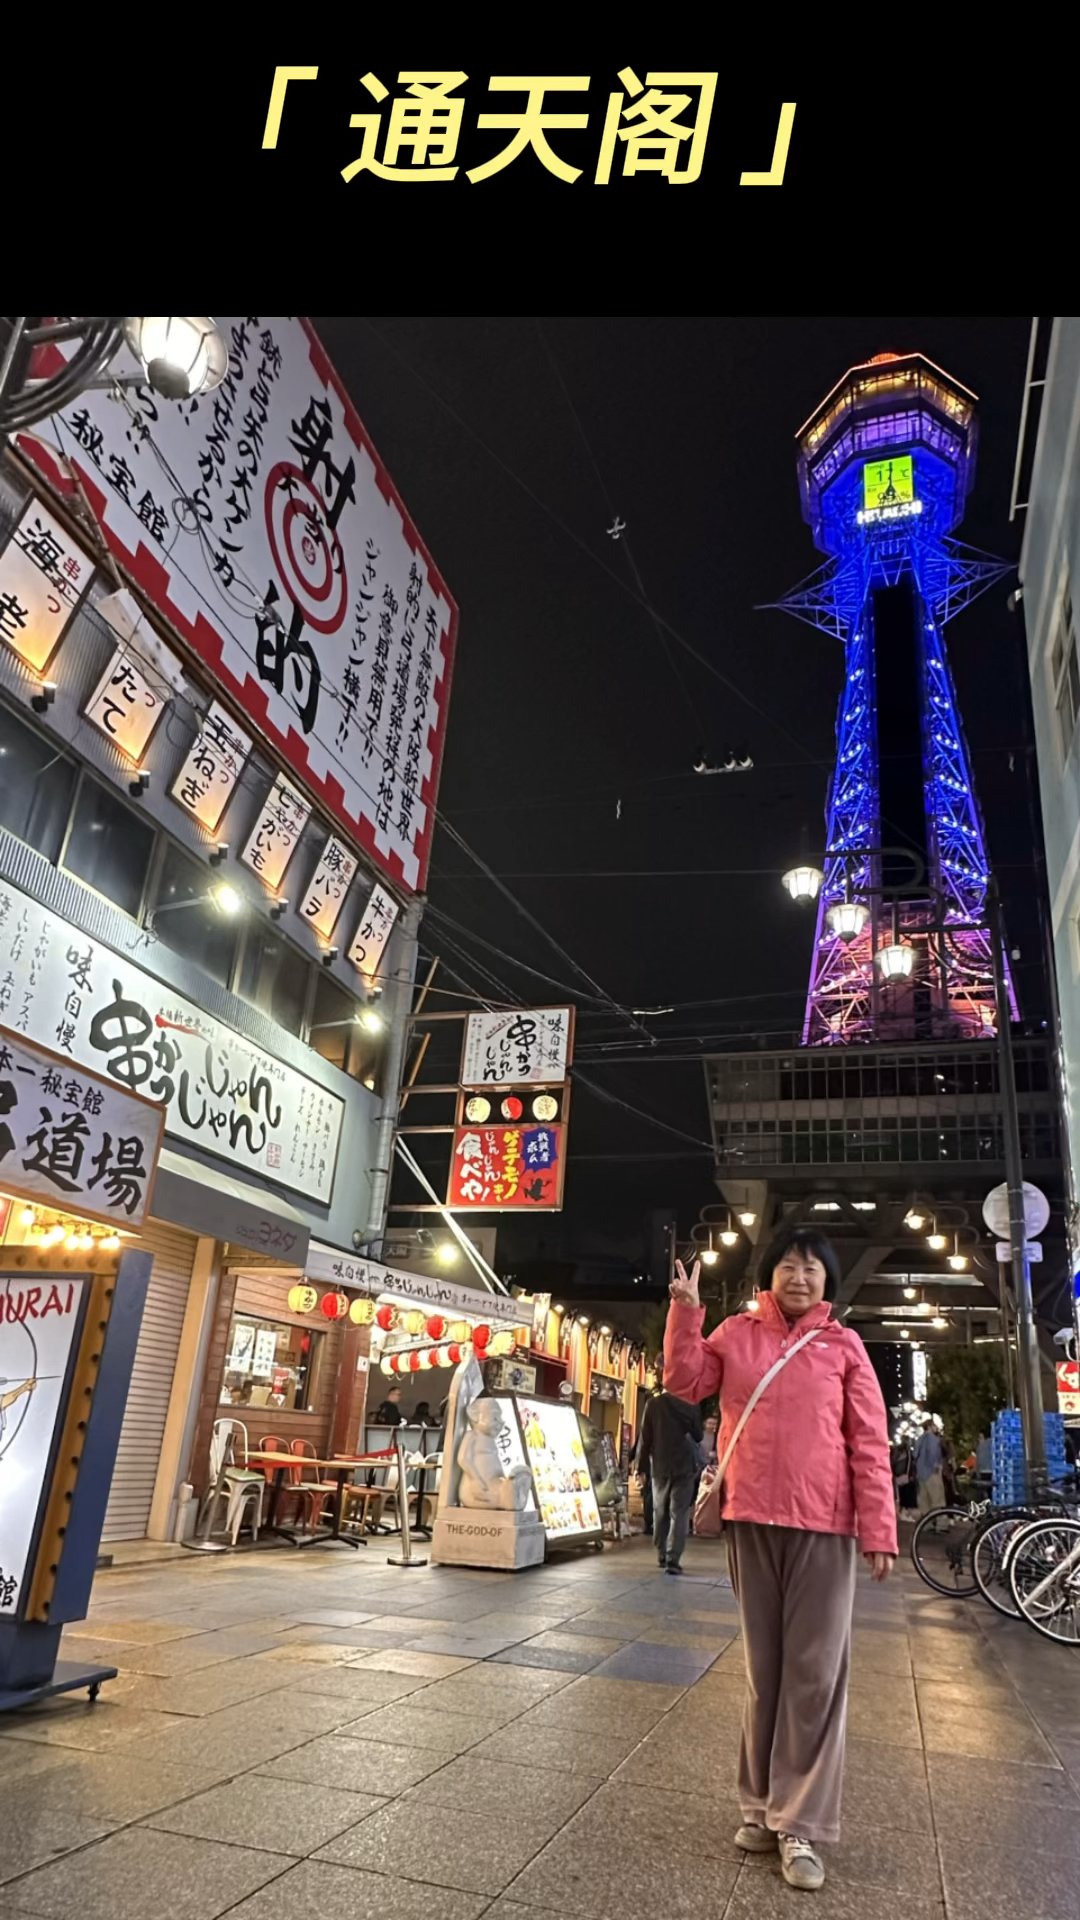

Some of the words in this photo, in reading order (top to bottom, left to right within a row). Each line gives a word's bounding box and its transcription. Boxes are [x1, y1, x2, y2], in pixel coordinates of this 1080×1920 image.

[69, 408, 169, 542] 秘宝館
[102, 664, 138, 735] たて
[398, 604, 437, 842] 天下無敵の大阪新世界
[180, 714, 234, 809] 玉ねぎ
[305, 842, 345, 916] 豚バラ
[355, 895, 385, 962] 牛かつ
[56, 945, 94, 1053] 味自慢
[502, 1130, 520, 1199] ゲテモノ
